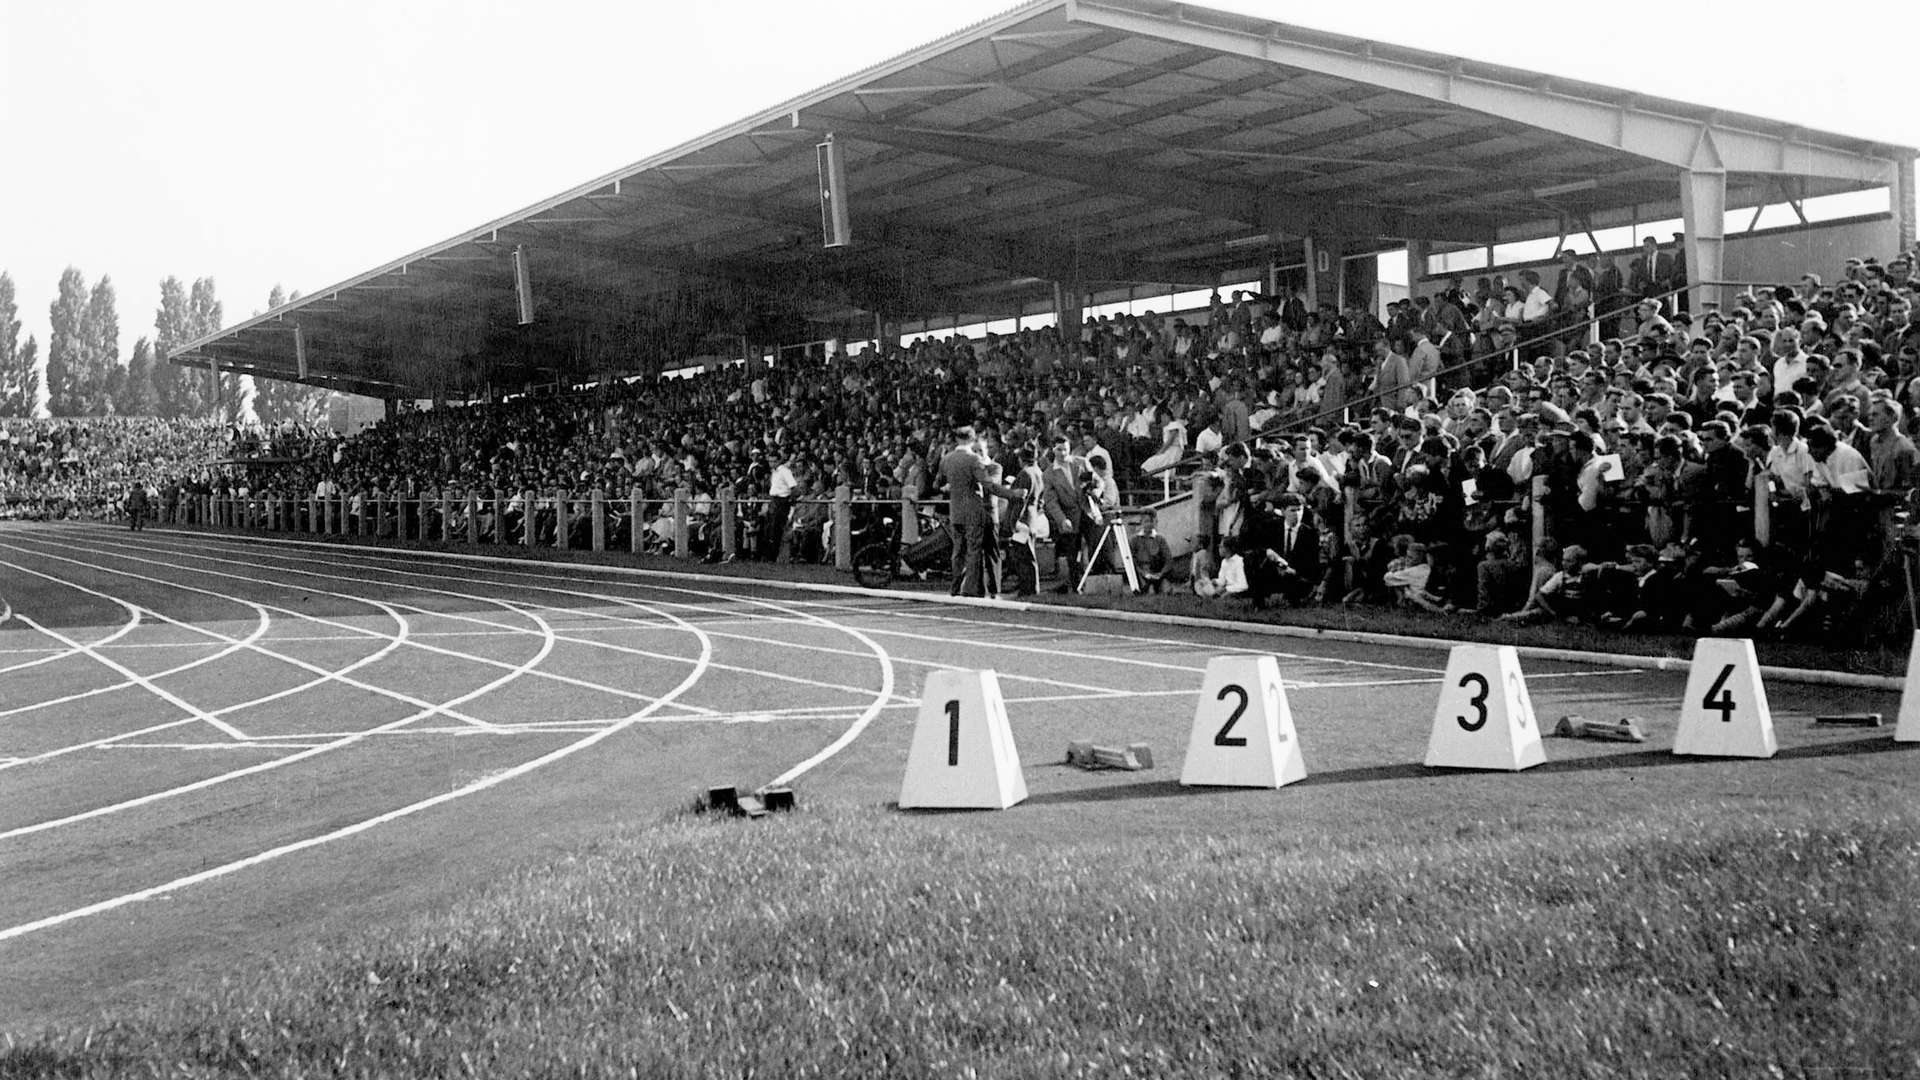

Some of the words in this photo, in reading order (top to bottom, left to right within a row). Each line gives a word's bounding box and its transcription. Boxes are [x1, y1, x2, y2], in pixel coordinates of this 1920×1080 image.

[1214, 684, 1248, 747] 2
[1268, 682, 1288, 742] 2
[1456, 672, 1489, 733] 3
[1703, 664, 1736, 722] 4
[944, 699, 960, 767] 1
